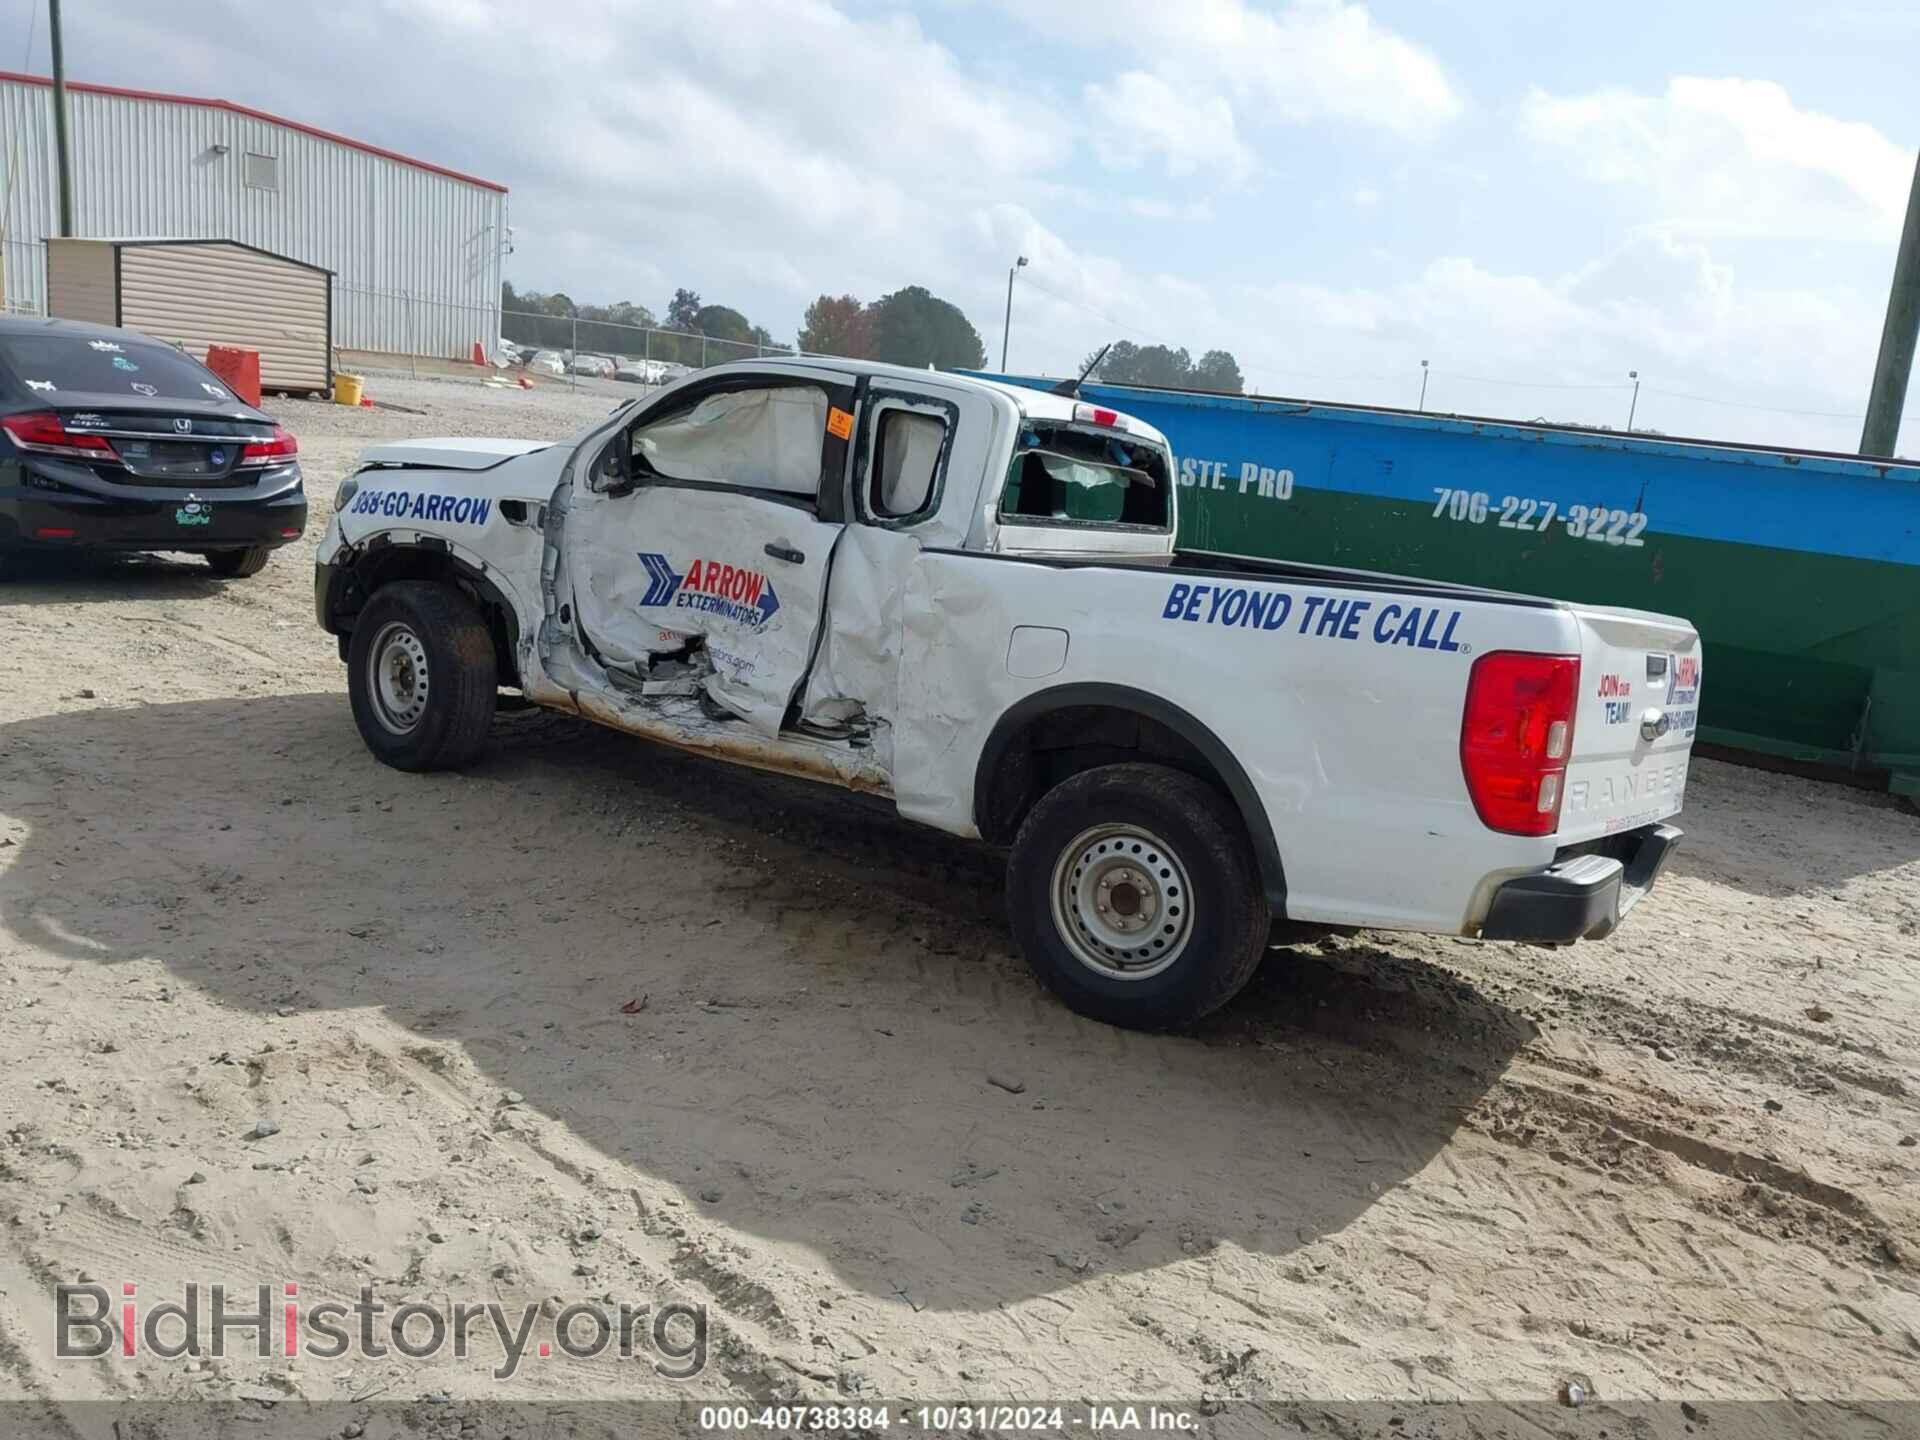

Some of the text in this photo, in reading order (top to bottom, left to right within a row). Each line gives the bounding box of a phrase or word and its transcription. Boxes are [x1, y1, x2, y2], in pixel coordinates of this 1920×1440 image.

[1238, 462, 1294, 500] PRO
[1432, 487, 1648, 547] 706-227-3222
[683, 559, 764, 606] ARROW
[676, 593, 760, 626] EXTERMINATORS
[1162, 583, 1292, 631] BEYOND
[1298, 597, 1370, 640] THE
[1598, 674, 1619, 697] JOIN
